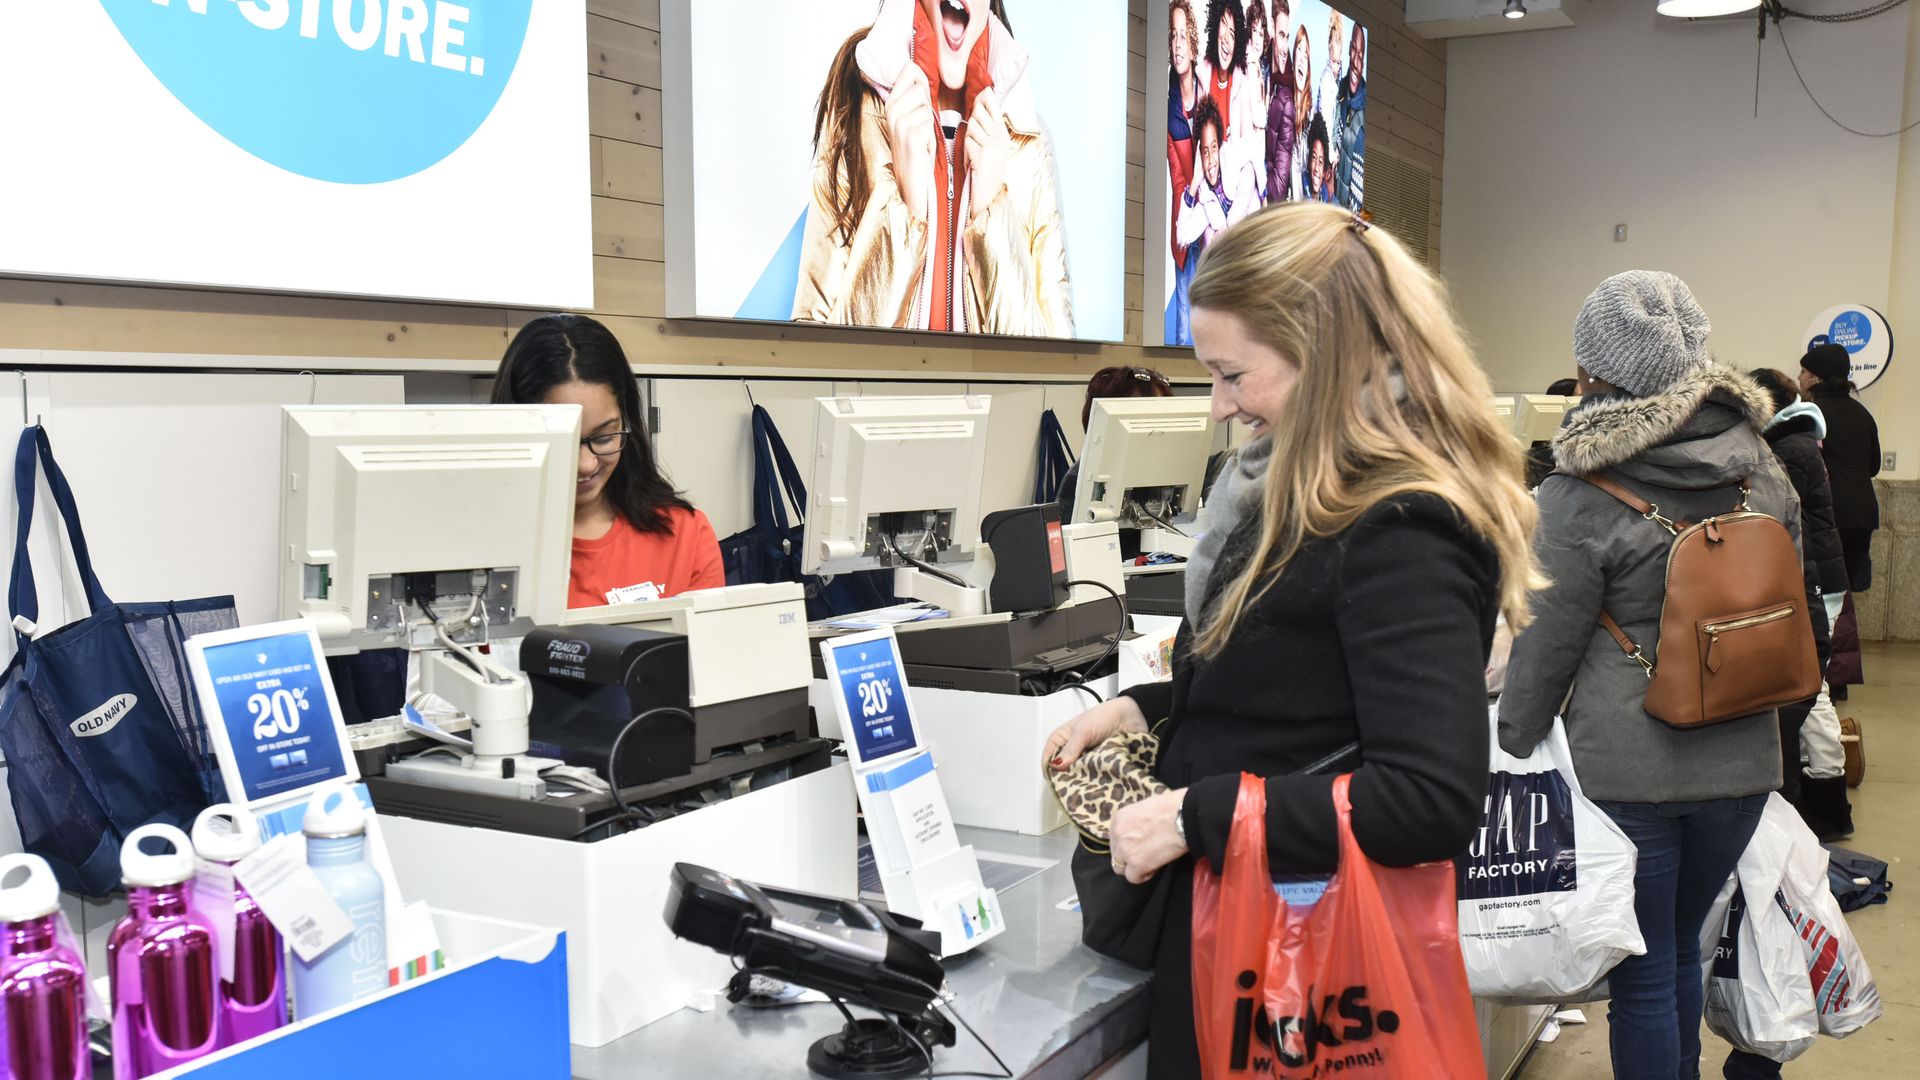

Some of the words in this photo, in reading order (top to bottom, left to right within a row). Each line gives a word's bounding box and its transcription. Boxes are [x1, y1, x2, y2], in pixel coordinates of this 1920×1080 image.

[1834, 333, 1858, 341] PICKUP
[778, 612, 796, 625] IBM
[547, 640, 581, 654] FRAUD
[549, 651, 585, 663] FIGHTER
[78, 716, 103, 733] OLD
[104, 697, 127, 723] NAVY
[1468, 859, 1548, 879] FACTORY
[1479, 899, 1541, 912] gapfactory.com
[1325, 1047, 1383, 1072] Penny!
